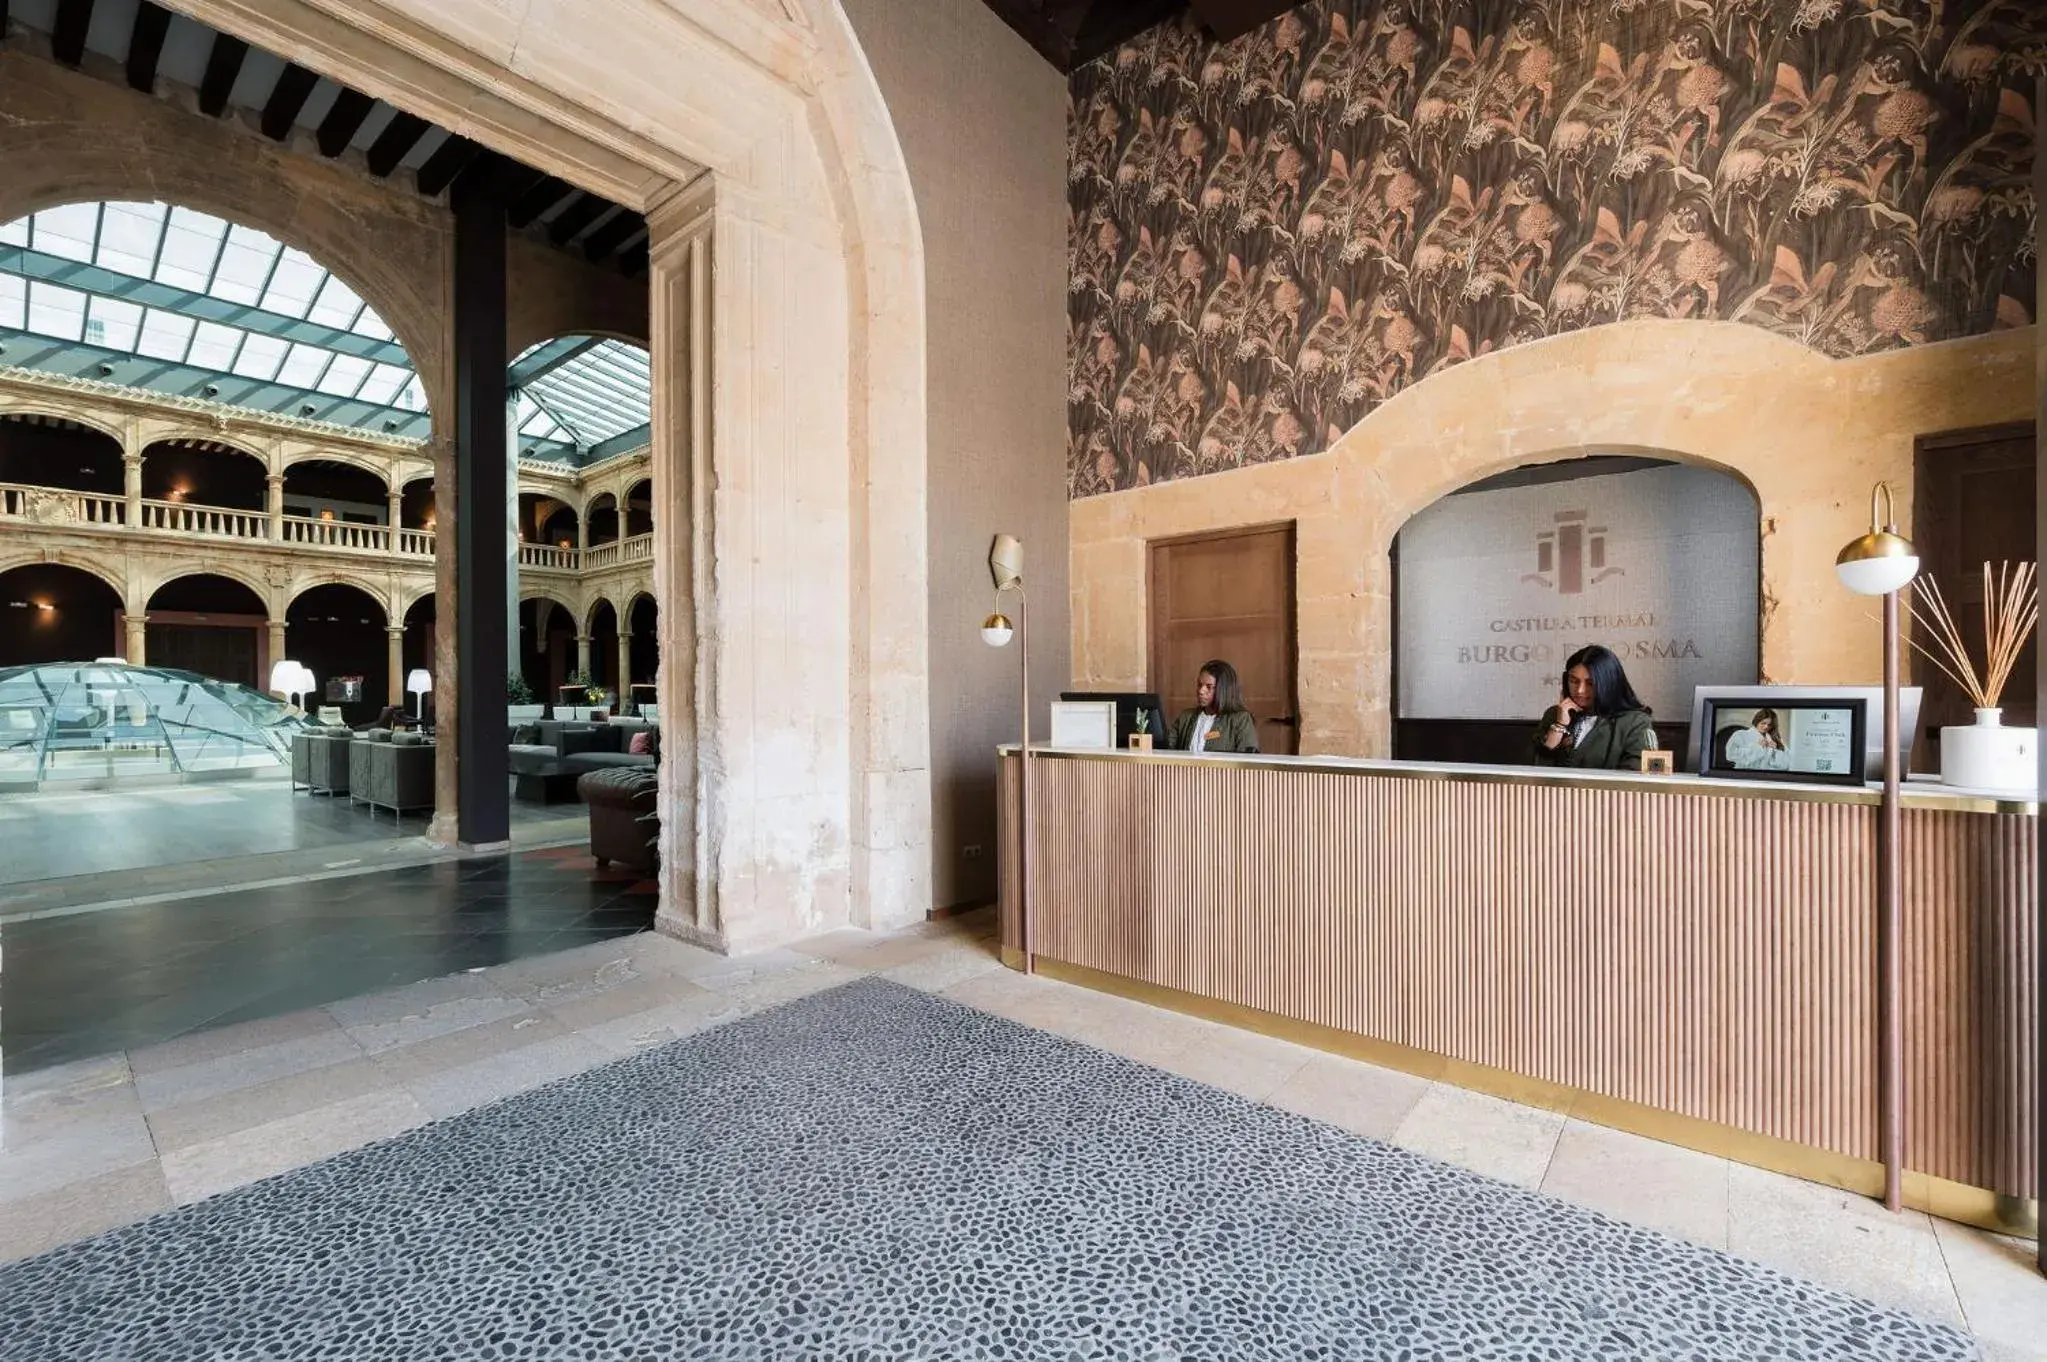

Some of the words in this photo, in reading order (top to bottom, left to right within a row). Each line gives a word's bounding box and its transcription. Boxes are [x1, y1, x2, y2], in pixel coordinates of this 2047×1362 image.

[1489, 616, 1576, 633] CASTILLA
[1577, 612, 1660, 629] TERMAL
[1457, 643, 1554, 664] BURGO
[1611, 638, 1704, 661] OSMA
